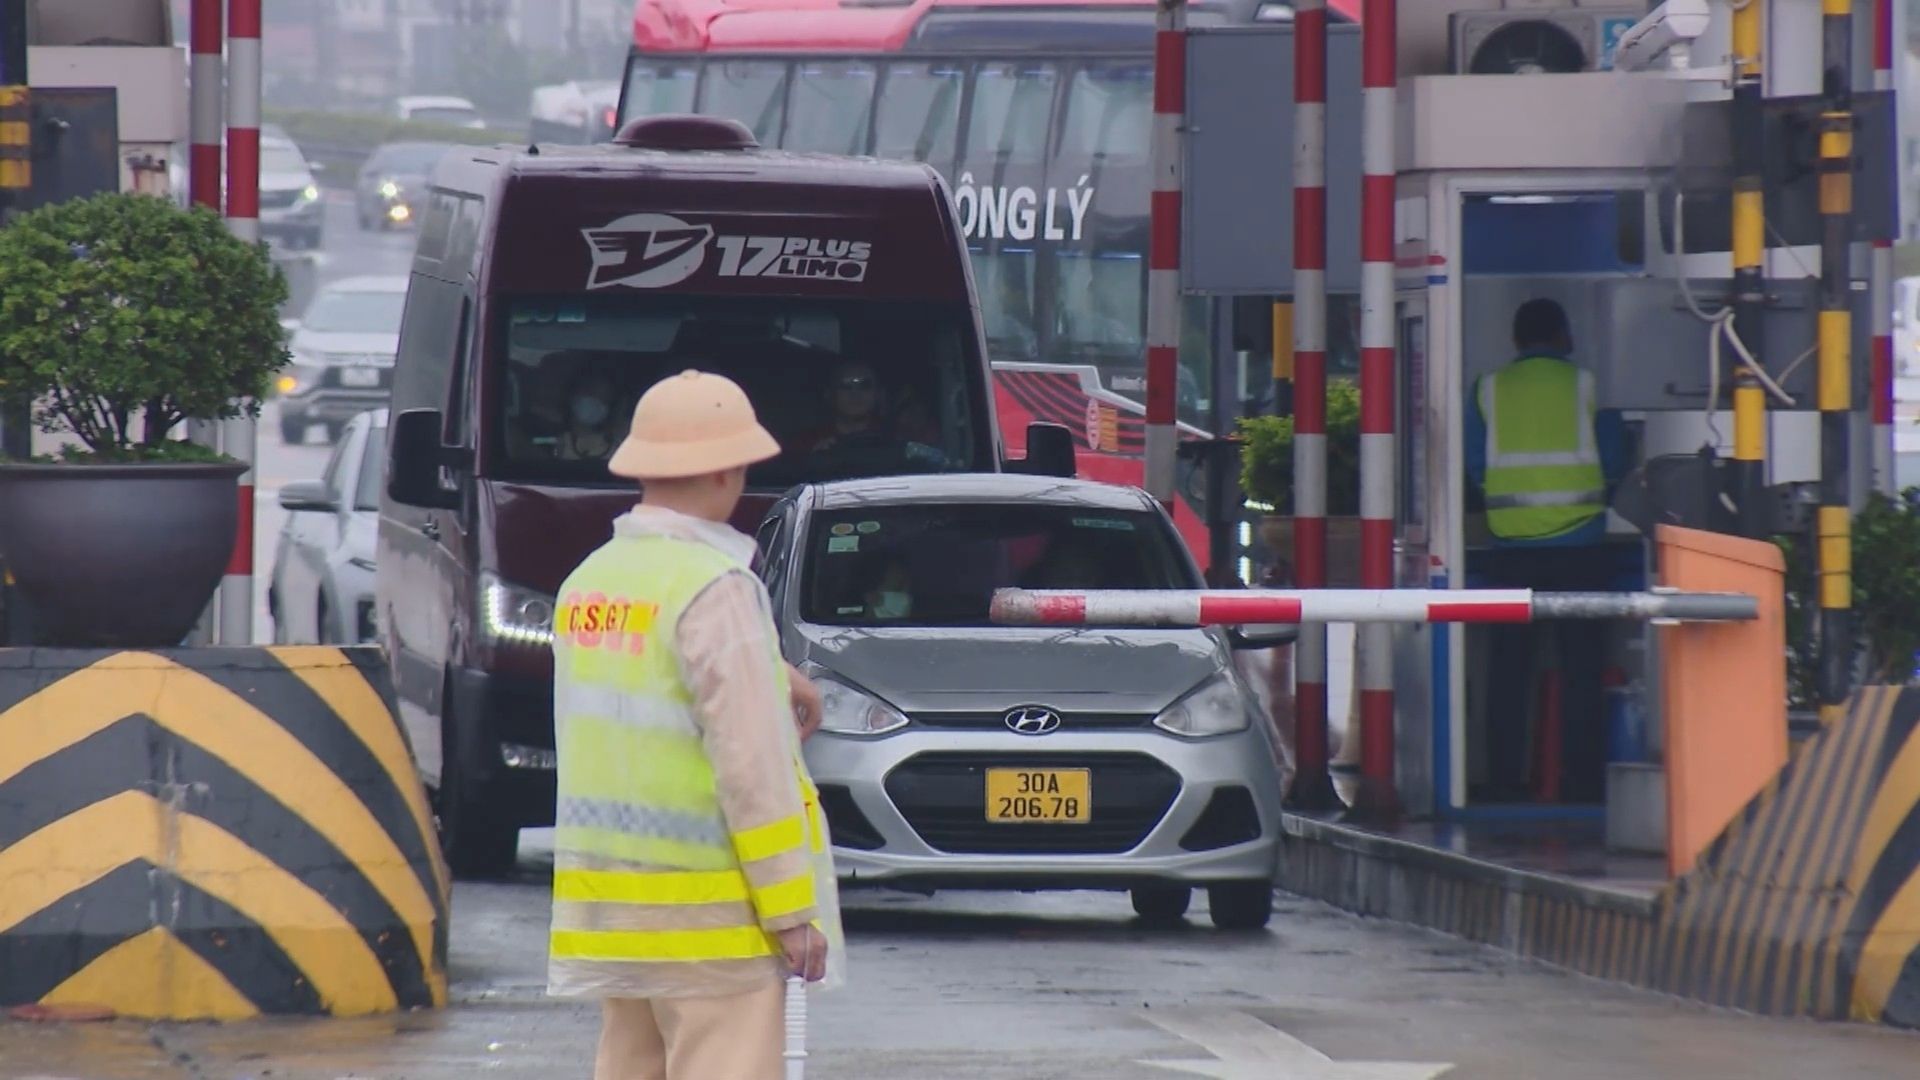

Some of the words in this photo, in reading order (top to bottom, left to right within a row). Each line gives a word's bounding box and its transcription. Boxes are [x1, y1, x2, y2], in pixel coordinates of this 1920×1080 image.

[1044, 174, 1095, 240] LÝ
[716, 236, 785, 276] 17
[783, 237, 872, 260] PLUS
[777, 257, 863, 280] LIMO
[1017, 772, 1060, 794] 30A
[998, 797, 1079, 819] 206.78
